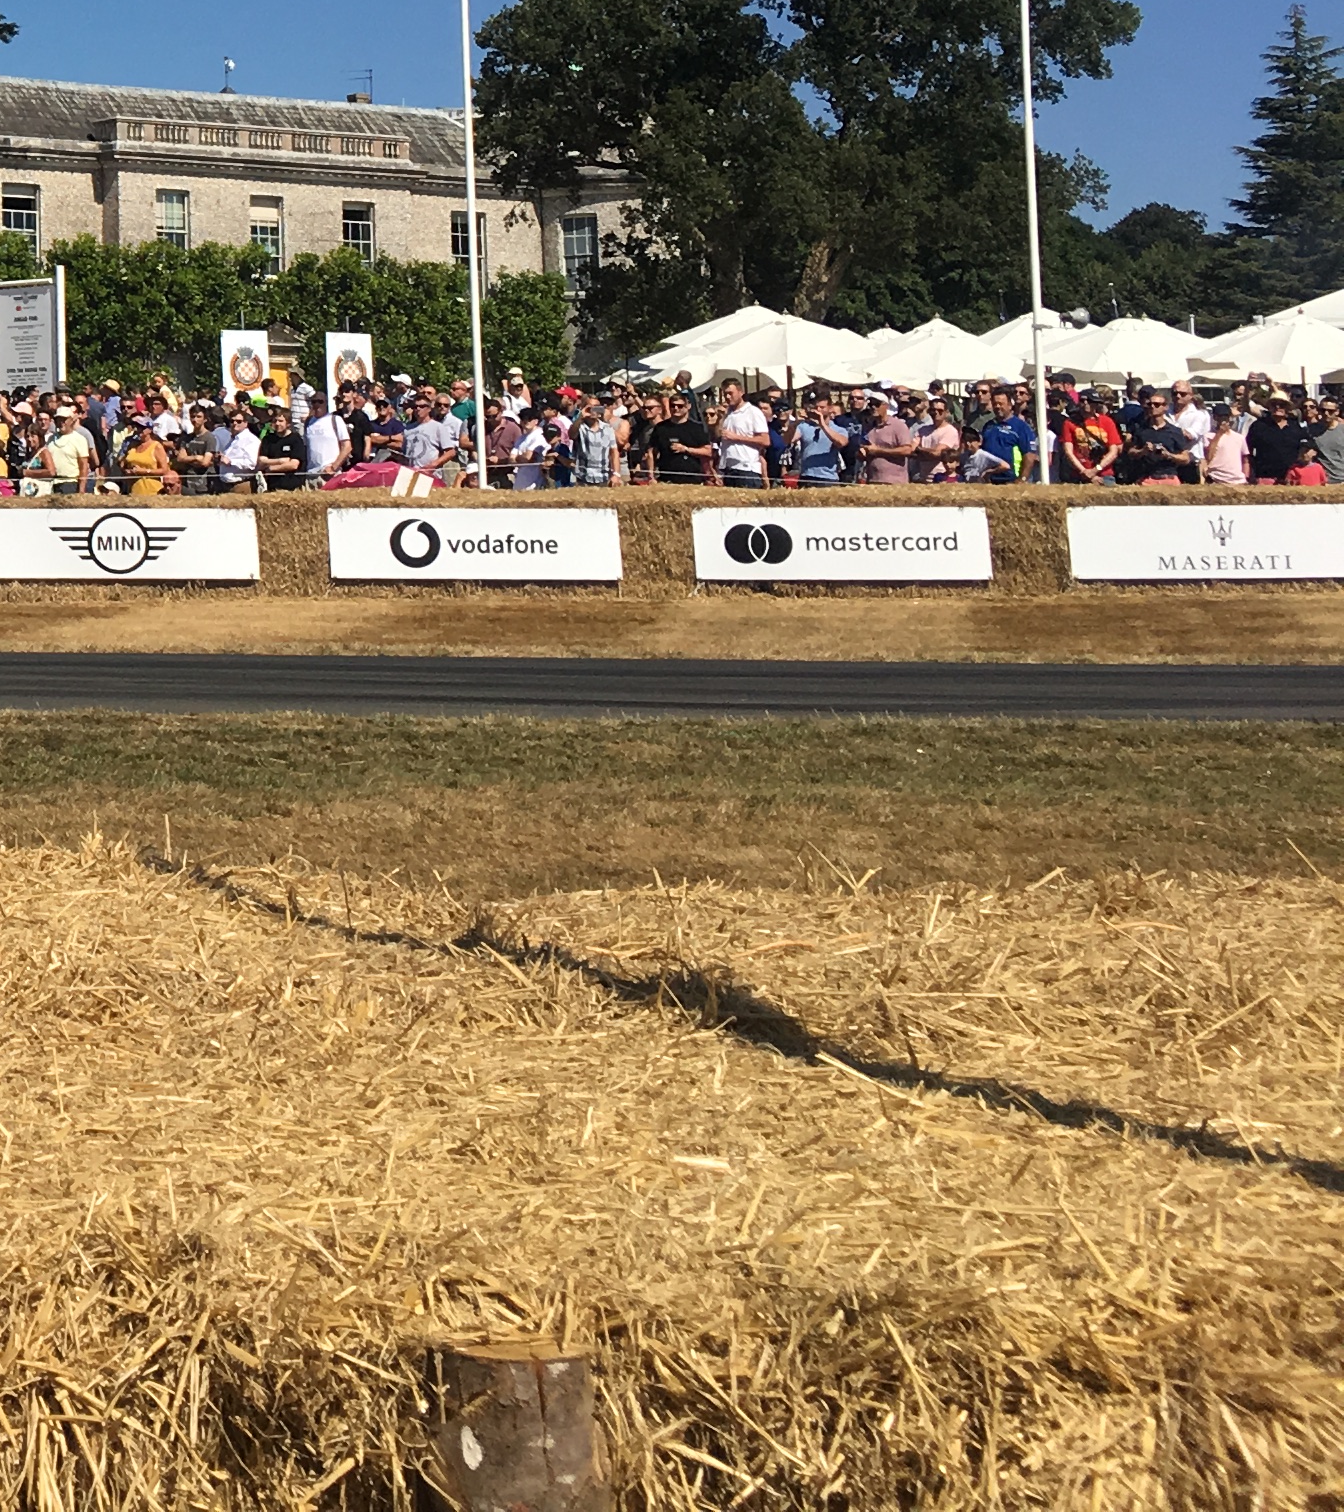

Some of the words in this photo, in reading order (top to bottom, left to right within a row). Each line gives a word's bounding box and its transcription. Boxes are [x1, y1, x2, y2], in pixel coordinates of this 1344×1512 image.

[97, 535, 142, 551] MINI
[446, 533, 559, 554] vodafone
[805, 531, 959, 552] mastercard
[1157, 554, 1293, 571] MASERATI
